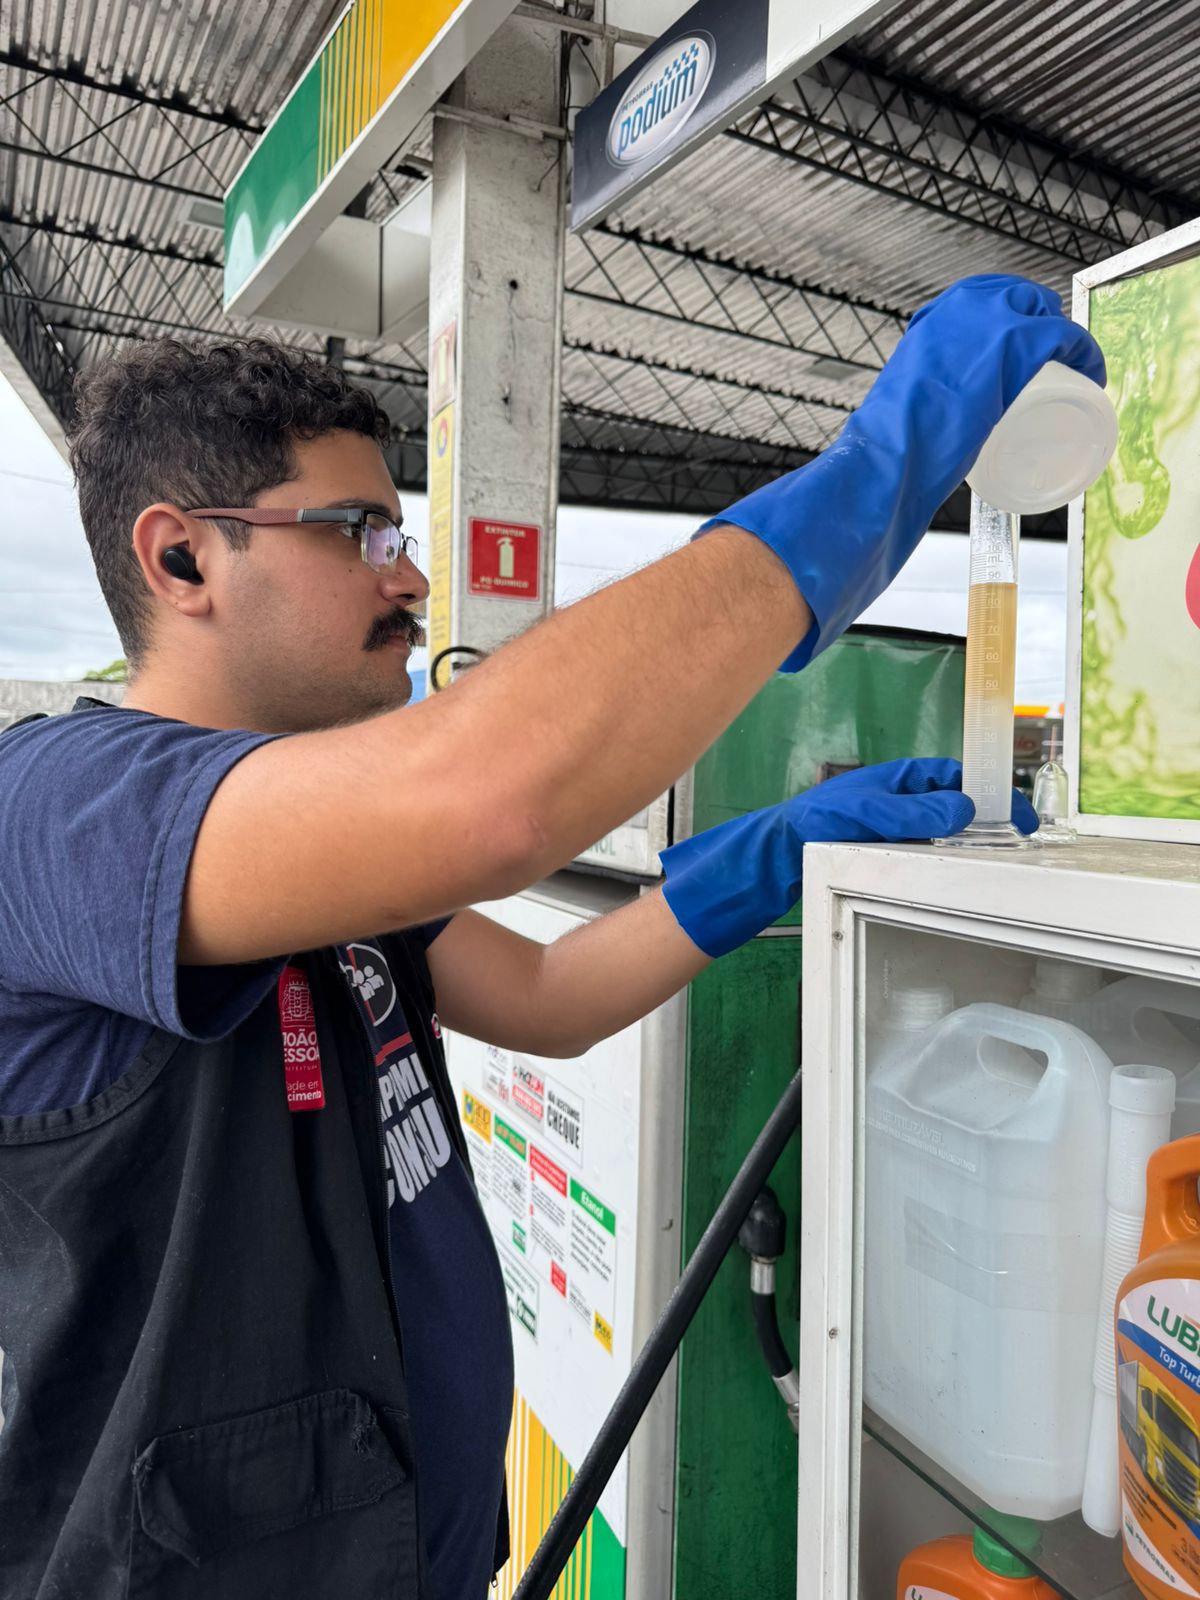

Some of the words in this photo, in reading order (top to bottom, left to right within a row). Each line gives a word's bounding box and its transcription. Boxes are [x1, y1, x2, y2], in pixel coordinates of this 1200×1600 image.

[617, 60, 698, 160] podium
[484, 525, 526, 537] EXTINTOR
[988, 571, 1001, 579] 90
[986, 625, 1000, 634] 70
[985, 652, 999, 661] 60
[985, 680, 999, 689] 50
[983, 759, 997, 768] 20
[984, 785, 997, 793] 10
[547, 1104, 580, 1150] CHEQUE
[580, 1189, 605, 1220] Etanol
[1147, 1295, 1200, 1358] LUB
[1160, 1346, 1177, 1370] Top
[1135, 1532, 1176, 1583] PETROBRAS
